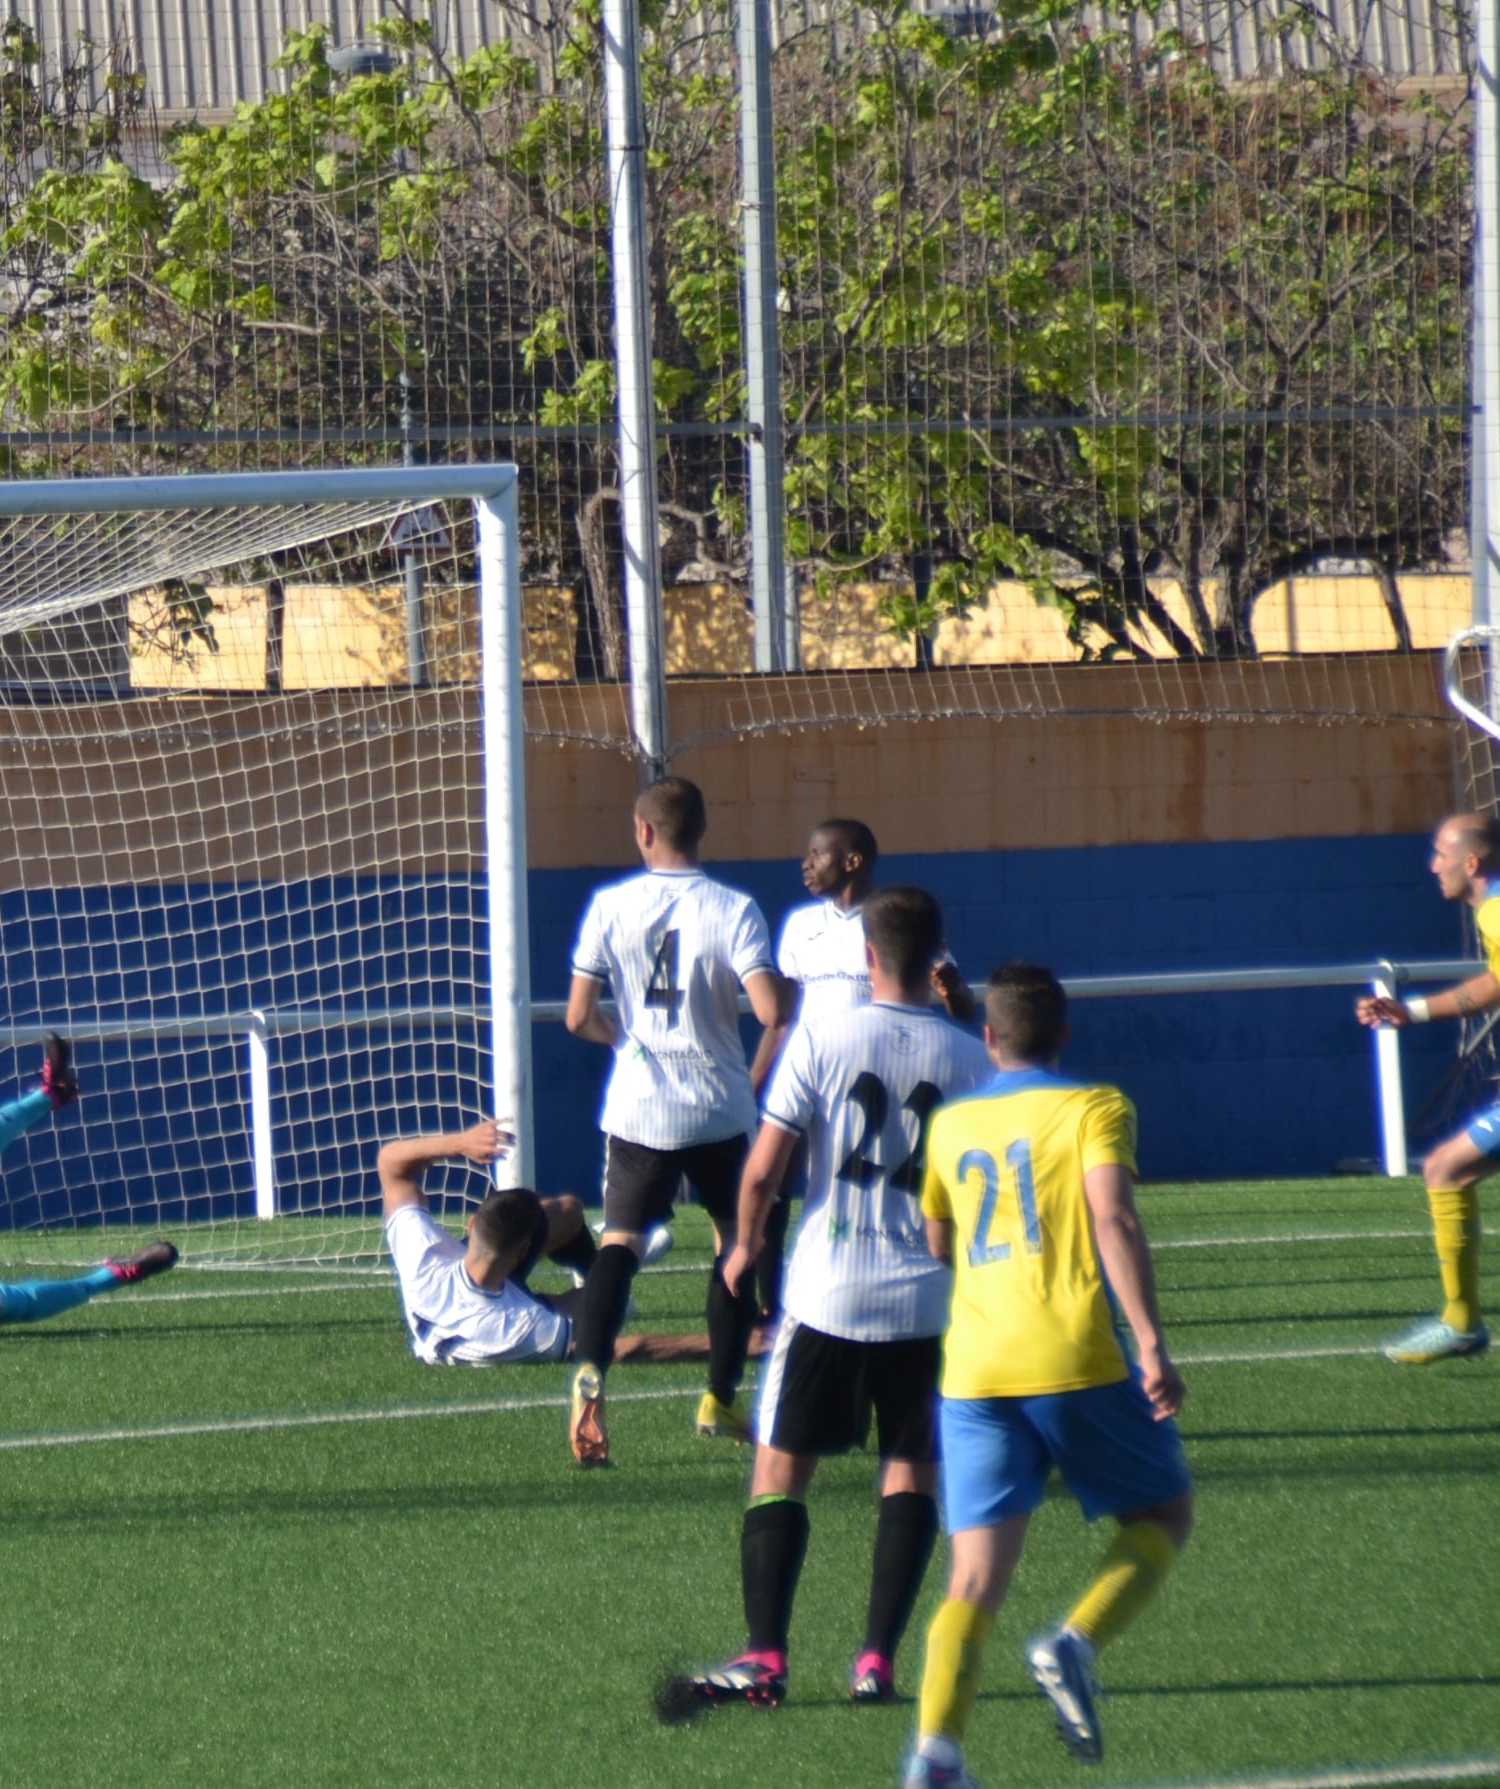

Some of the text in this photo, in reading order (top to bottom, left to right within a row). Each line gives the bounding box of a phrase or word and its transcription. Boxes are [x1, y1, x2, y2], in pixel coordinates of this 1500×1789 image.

[643, 928, 686, 1031] 4
[836, 1071, 944, 1197] 22
[957, 1137, 1043, 1267] 21
